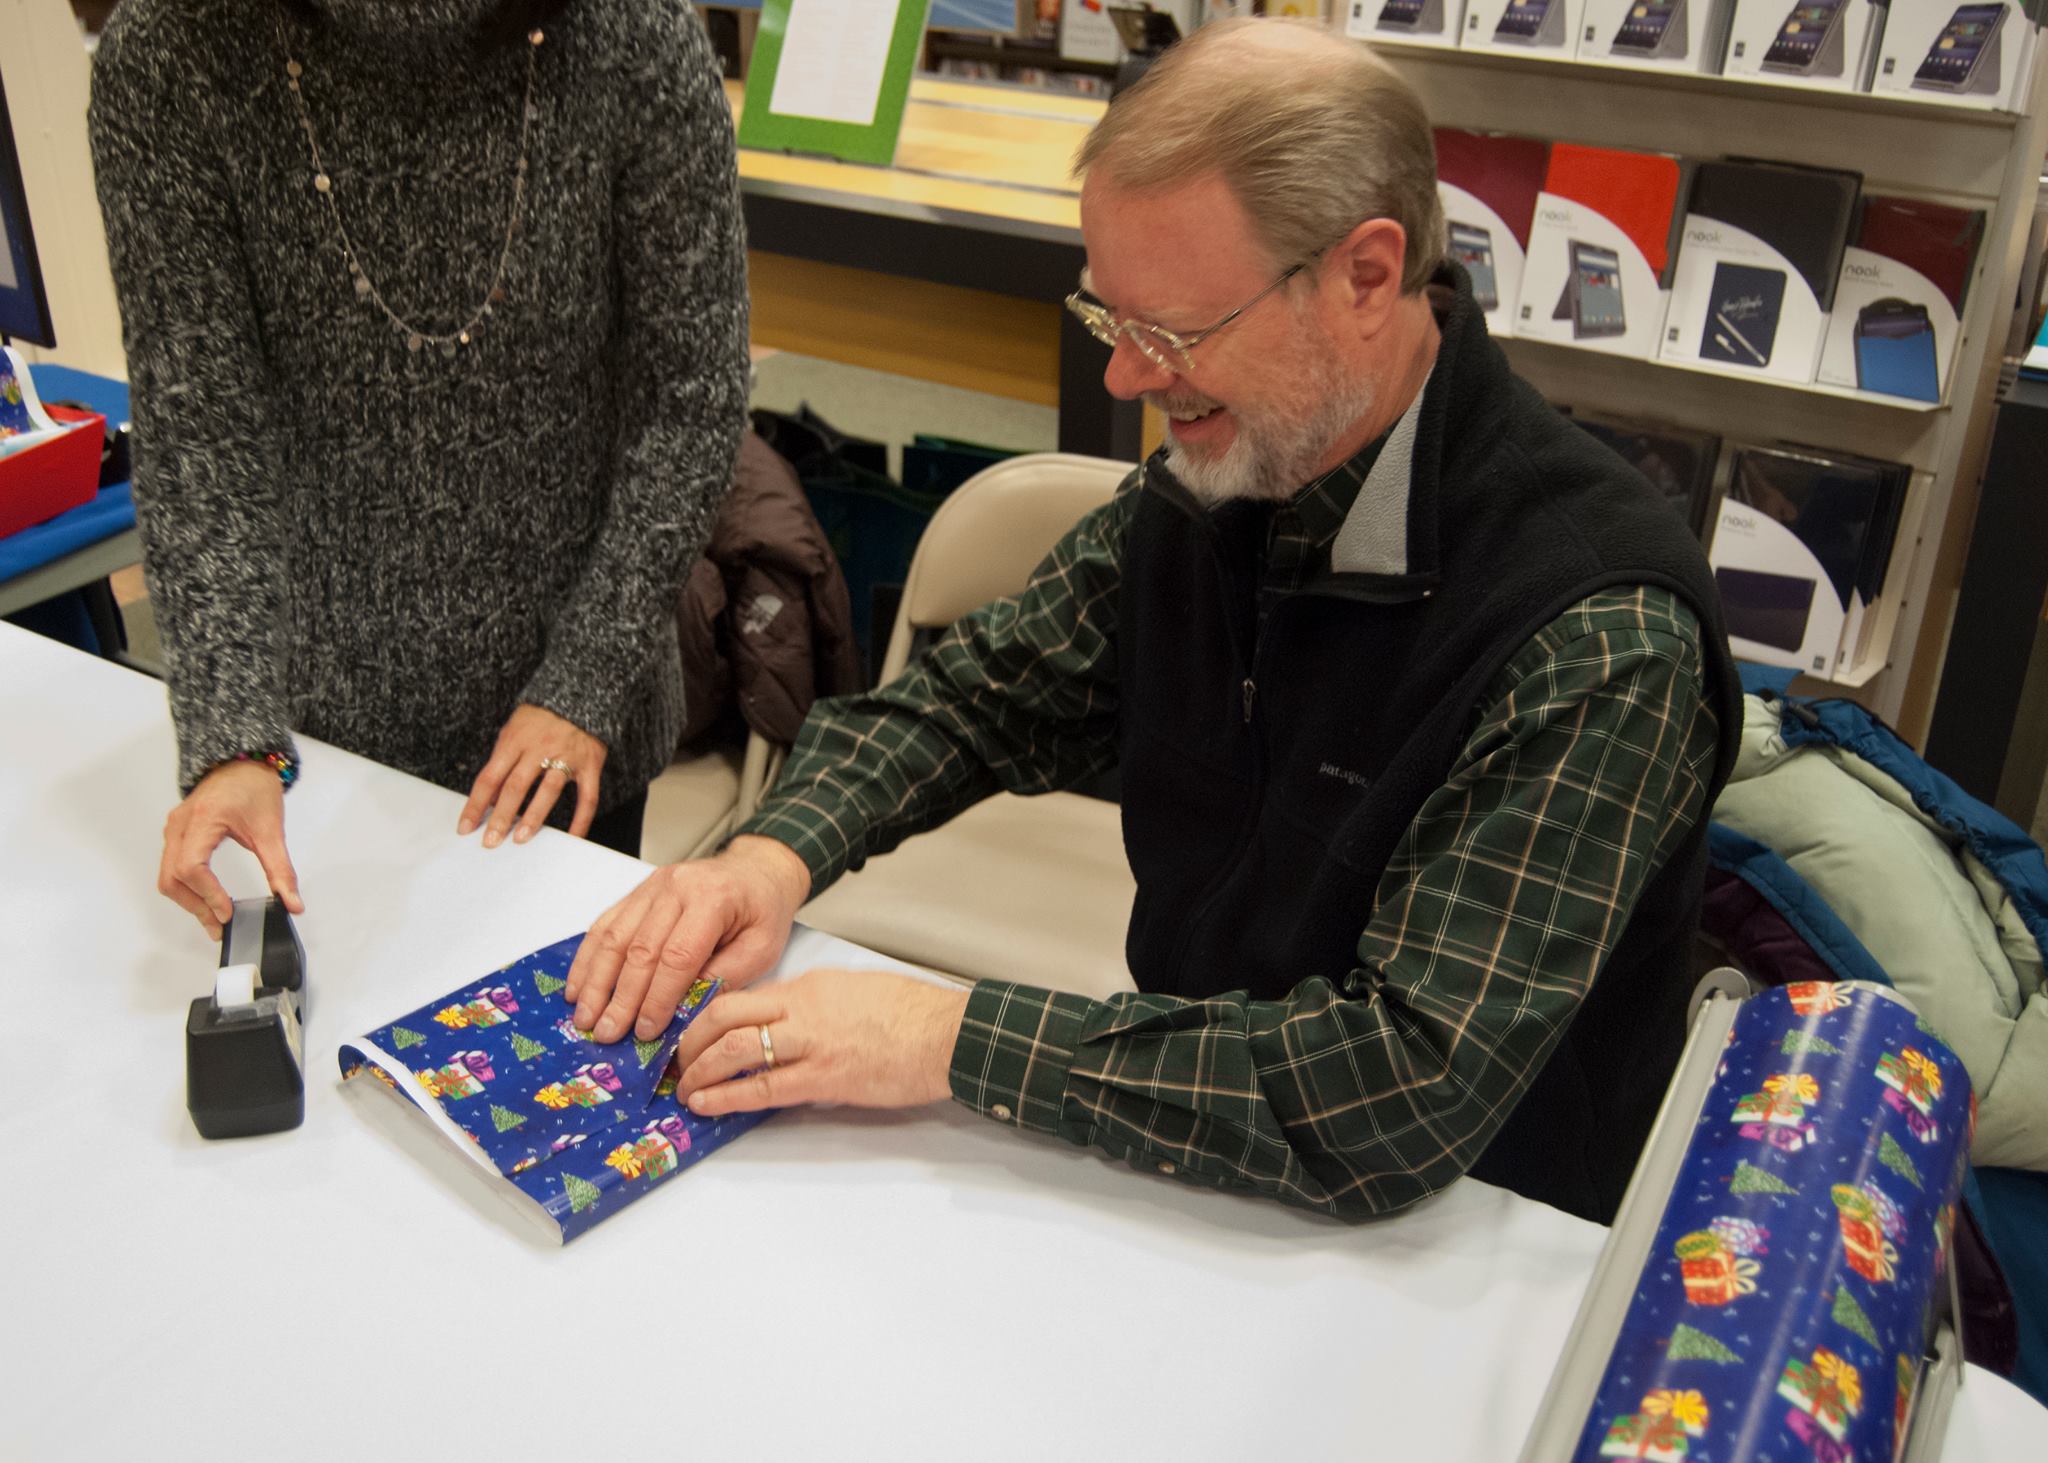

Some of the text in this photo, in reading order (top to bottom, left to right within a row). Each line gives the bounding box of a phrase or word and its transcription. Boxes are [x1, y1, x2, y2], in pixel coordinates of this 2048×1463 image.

[1687, 230, 1722, 243] nook
[1844, 264, 1880, 278] nook
[1723, 514, 1757, 529] nook
